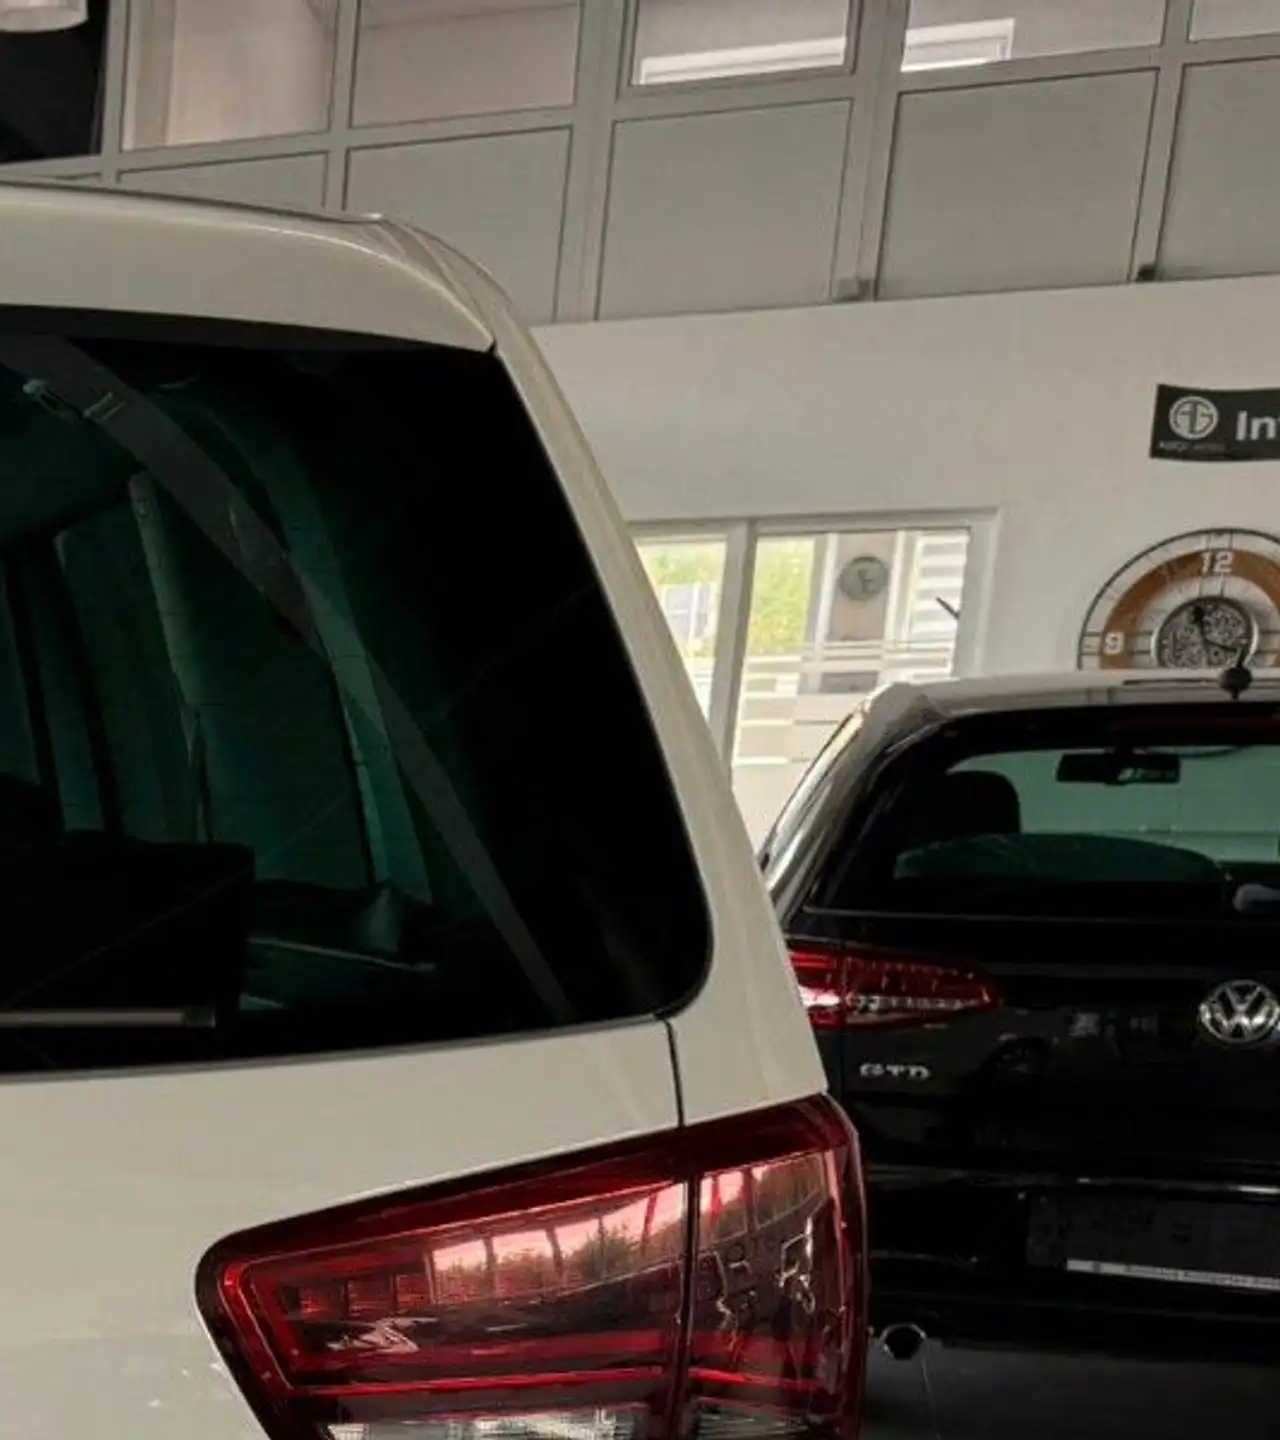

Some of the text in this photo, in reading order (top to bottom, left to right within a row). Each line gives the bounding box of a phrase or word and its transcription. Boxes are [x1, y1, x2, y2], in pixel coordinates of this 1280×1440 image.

[1236, 410, 1280, 441] In
[1201, 551, 1234, 574] 12
[1104, 632, 1125, 654] 9
[860, 1063, 929, 1078] GTD
